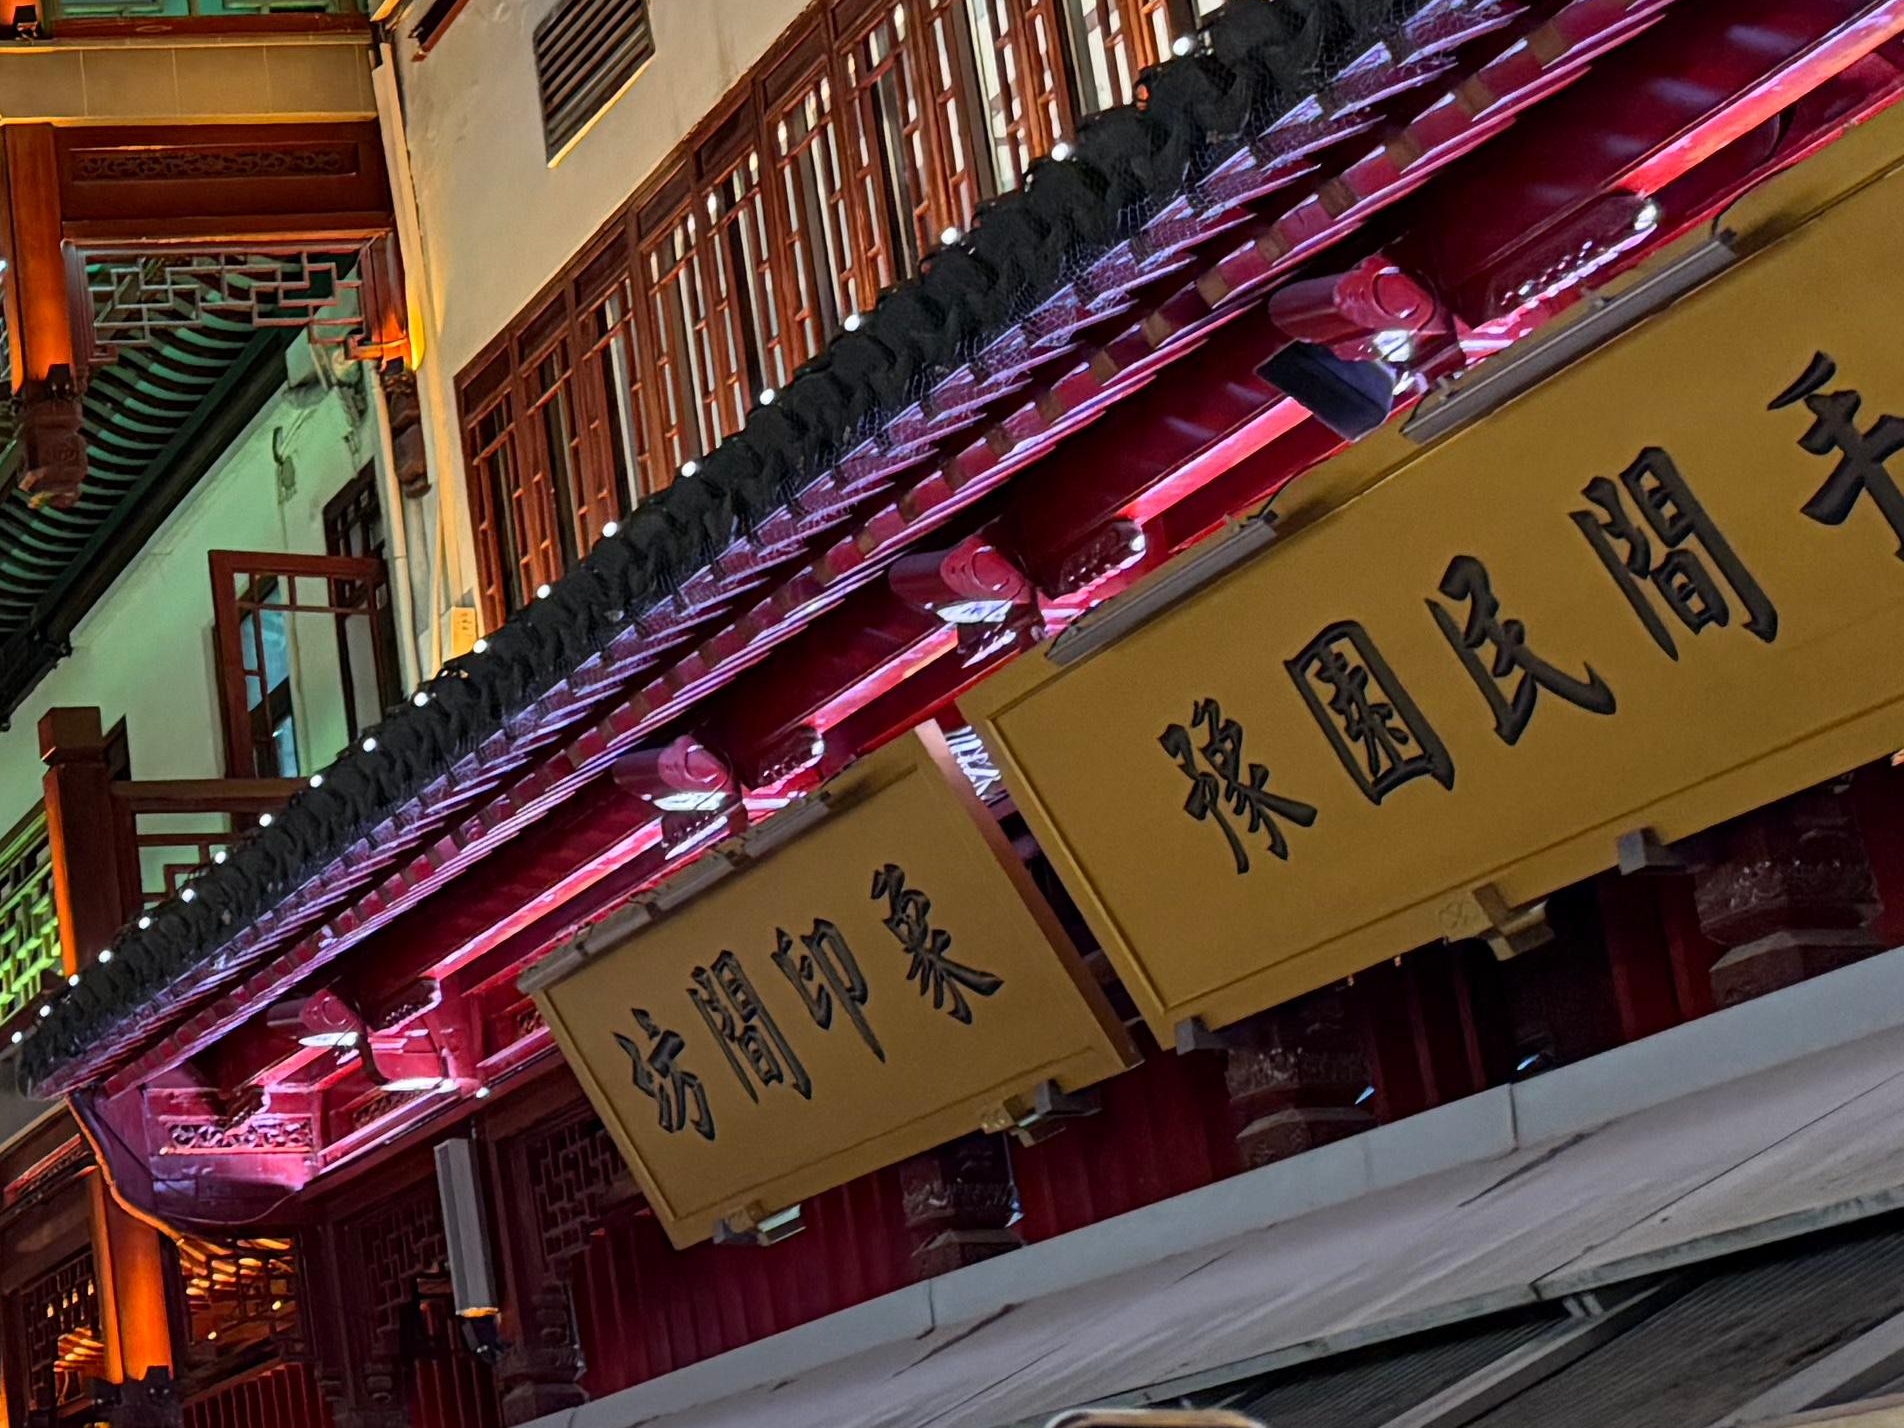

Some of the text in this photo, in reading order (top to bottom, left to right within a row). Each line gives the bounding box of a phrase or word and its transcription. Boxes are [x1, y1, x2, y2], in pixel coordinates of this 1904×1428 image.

[1158, 351, 1904, 874] 豫園民間手
[613, 864, 1004, 1142] 坊間印象
